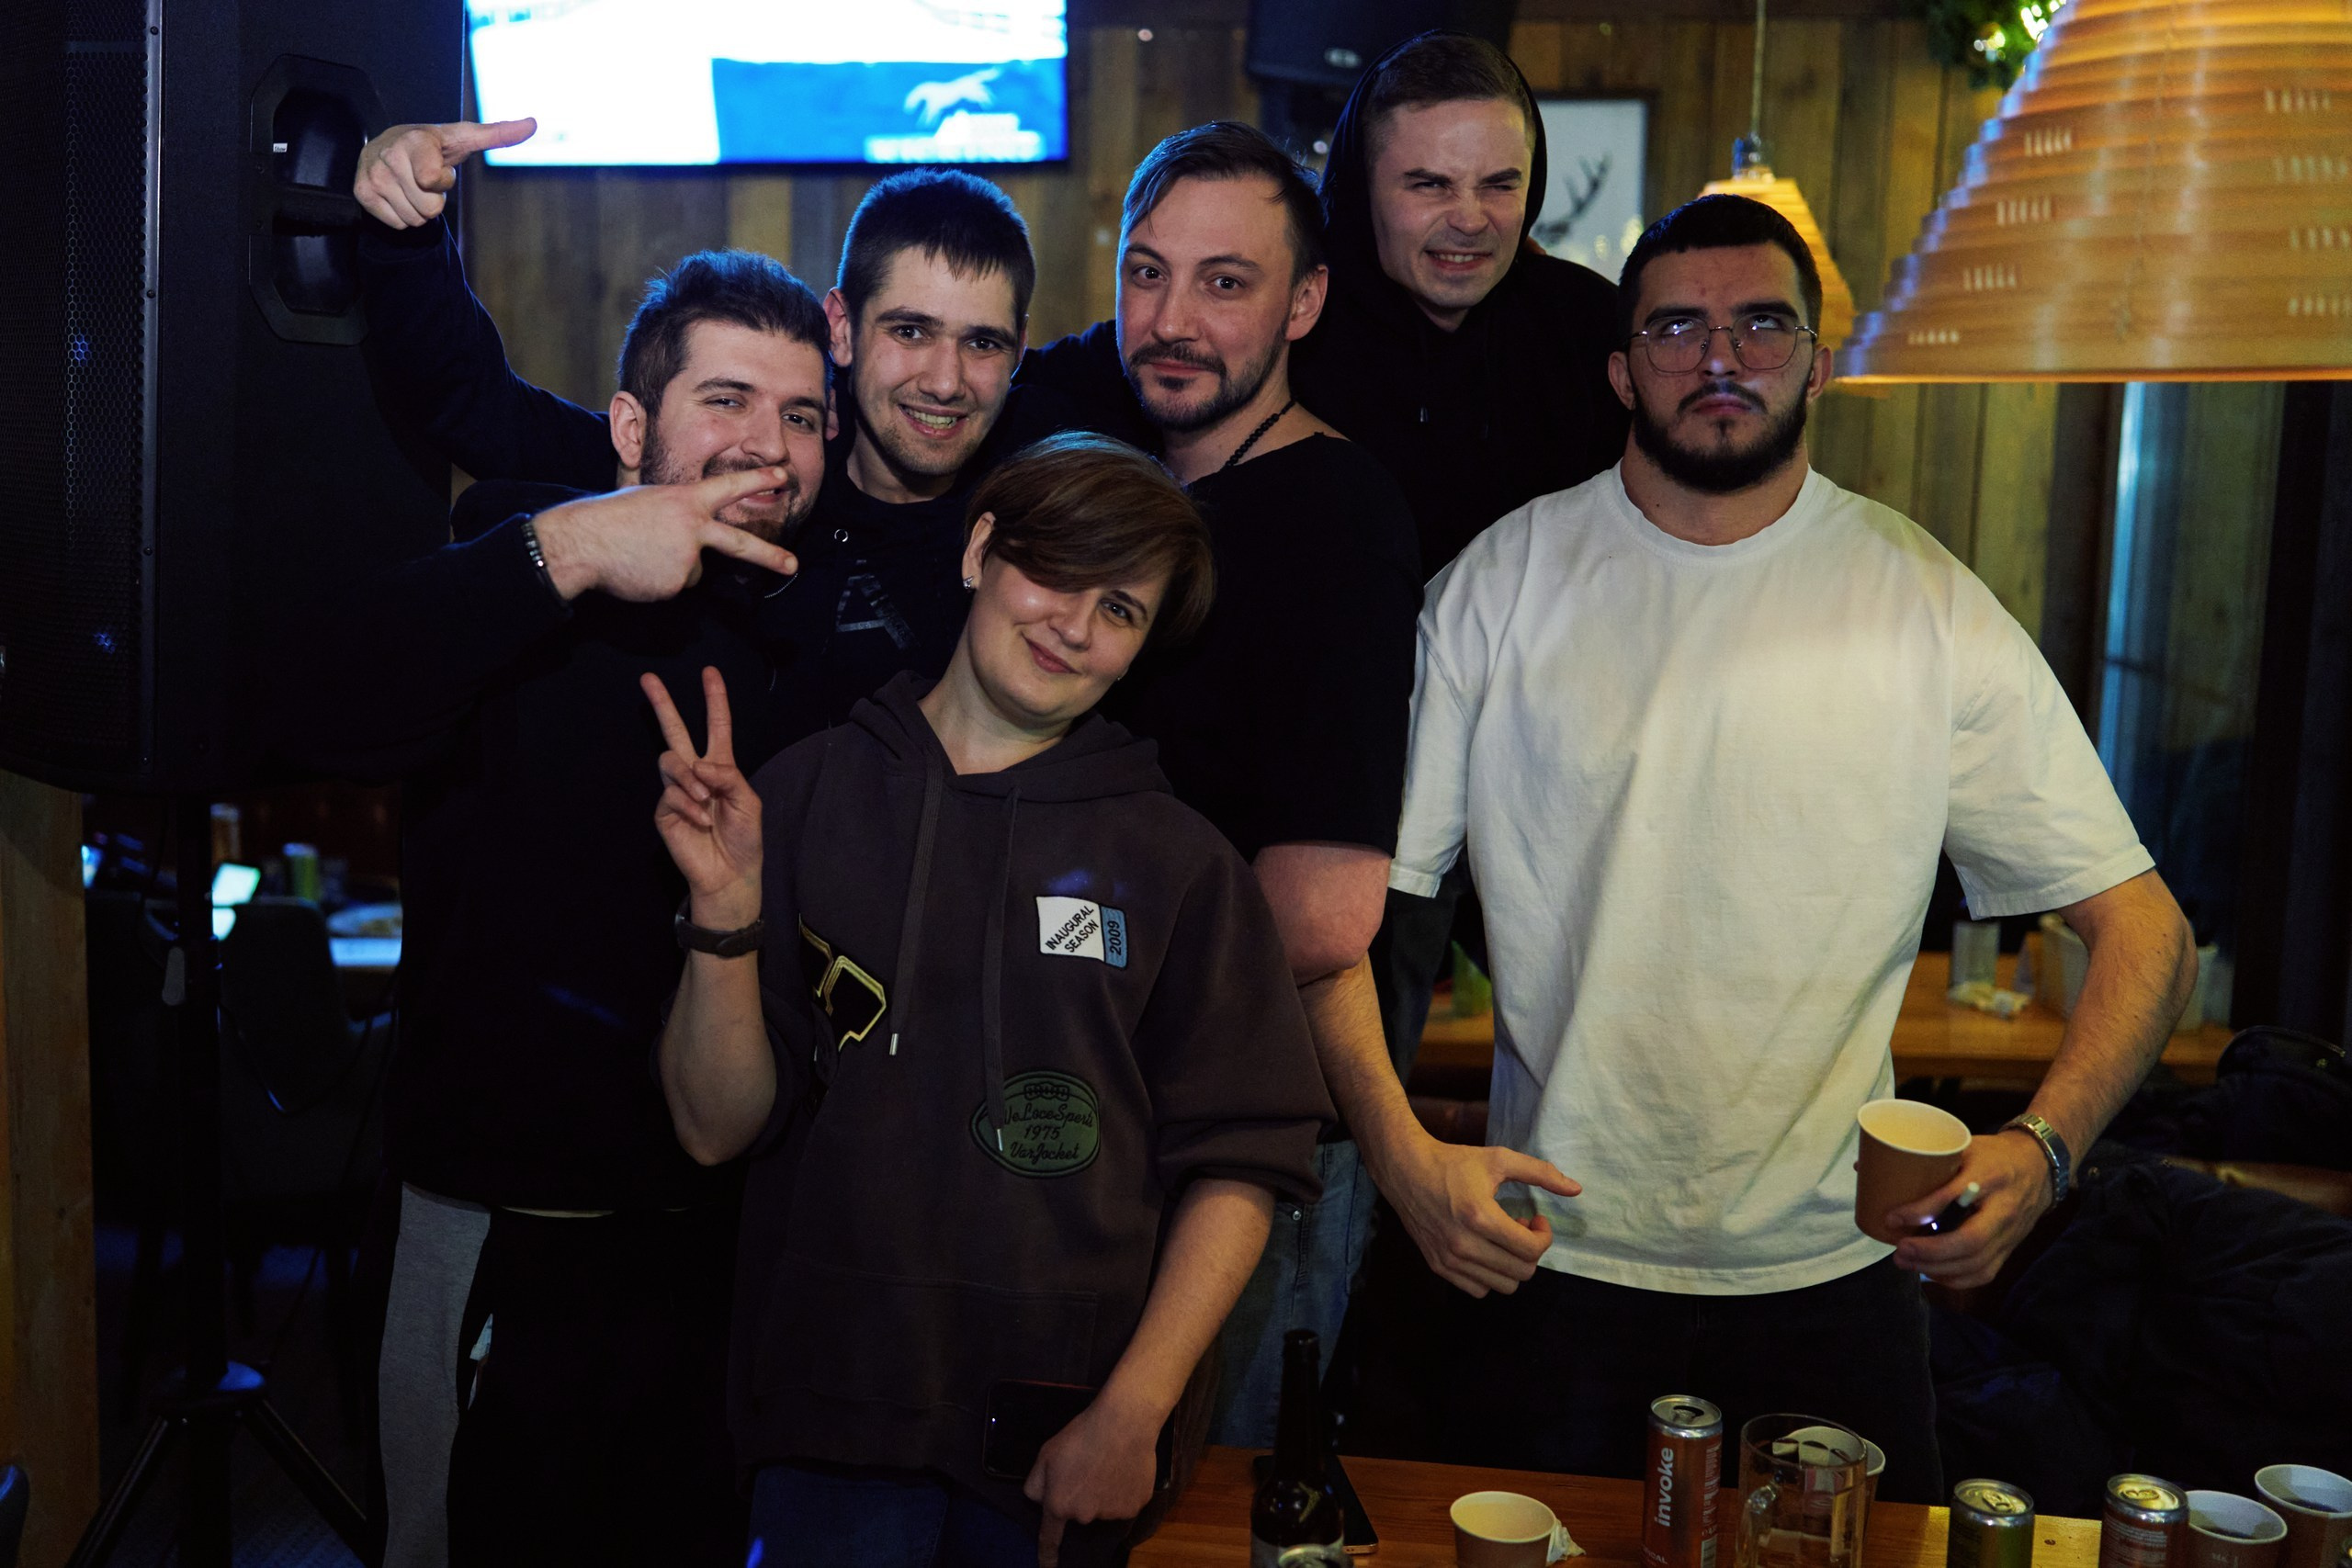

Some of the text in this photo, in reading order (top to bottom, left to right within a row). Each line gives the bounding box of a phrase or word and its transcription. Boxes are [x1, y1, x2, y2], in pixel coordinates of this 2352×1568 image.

[1045, 906, 1094, 950] INAUGURAL
[1064, 919, 1100, 953] SEASON
[1107, 920, 1122, 955] 2009
[1023, 1124, 1061, 1141] 1975
[1655, 1447, 1674, 1527] invoke
